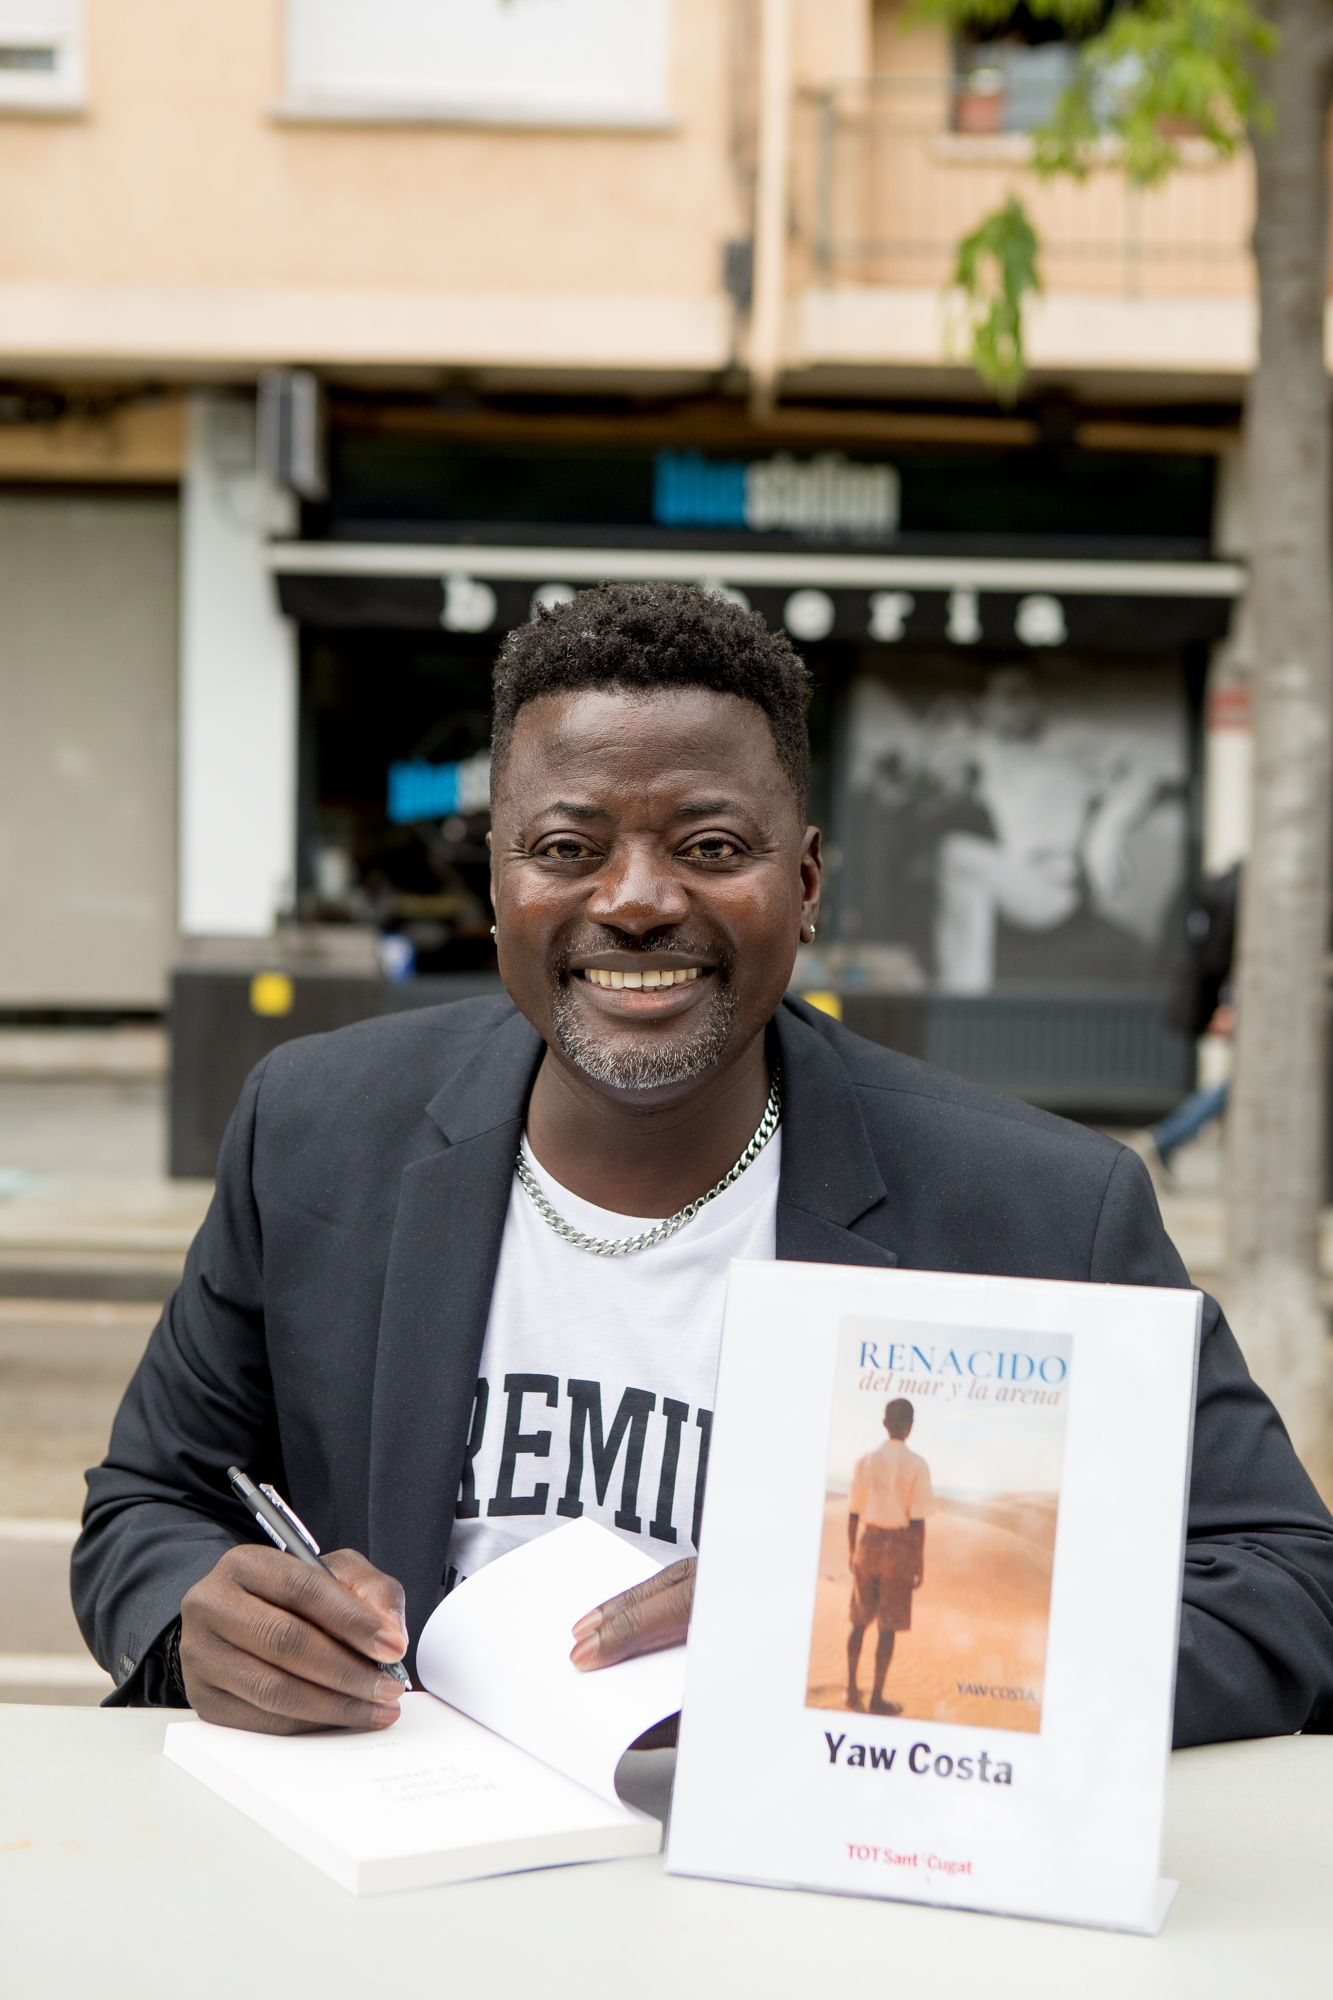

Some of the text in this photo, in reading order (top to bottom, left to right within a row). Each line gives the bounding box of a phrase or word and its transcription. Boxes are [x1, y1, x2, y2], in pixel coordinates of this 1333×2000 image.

[859, 1340, 1067, 1385] RENACIDO
[859, 1370, 1061, 1406] del mar y la arena
[956, 1681, 1036, 1703] YAW COSTA
[824, 1731, 1013, 1785] Yaw Costa
[848, 1844, 972, 1877] TOT Sant Cugat
